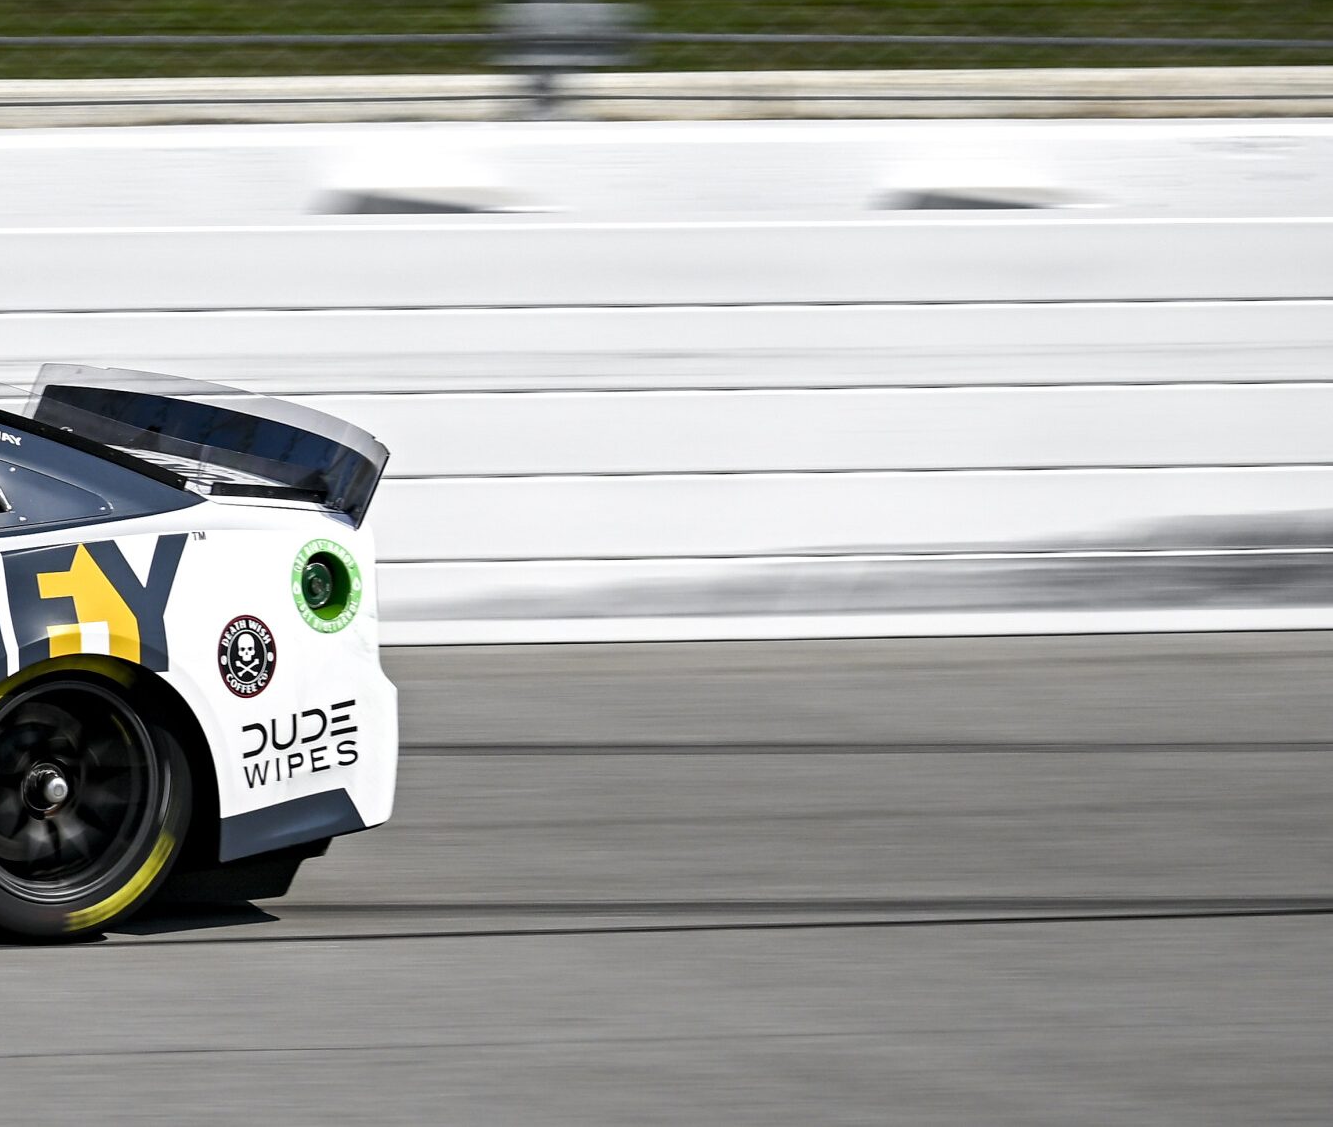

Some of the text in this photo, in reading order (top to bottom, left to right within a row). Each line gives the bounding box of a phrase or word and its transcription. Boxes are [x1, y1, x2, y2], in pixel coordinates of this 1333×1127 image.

[221, 619, 271, 647] DEATH WISH
[226, 674, 258, 694] COFFEE
[242, 699, 358, 759] DUDE
[243, 740, 359, 789] WIPES
